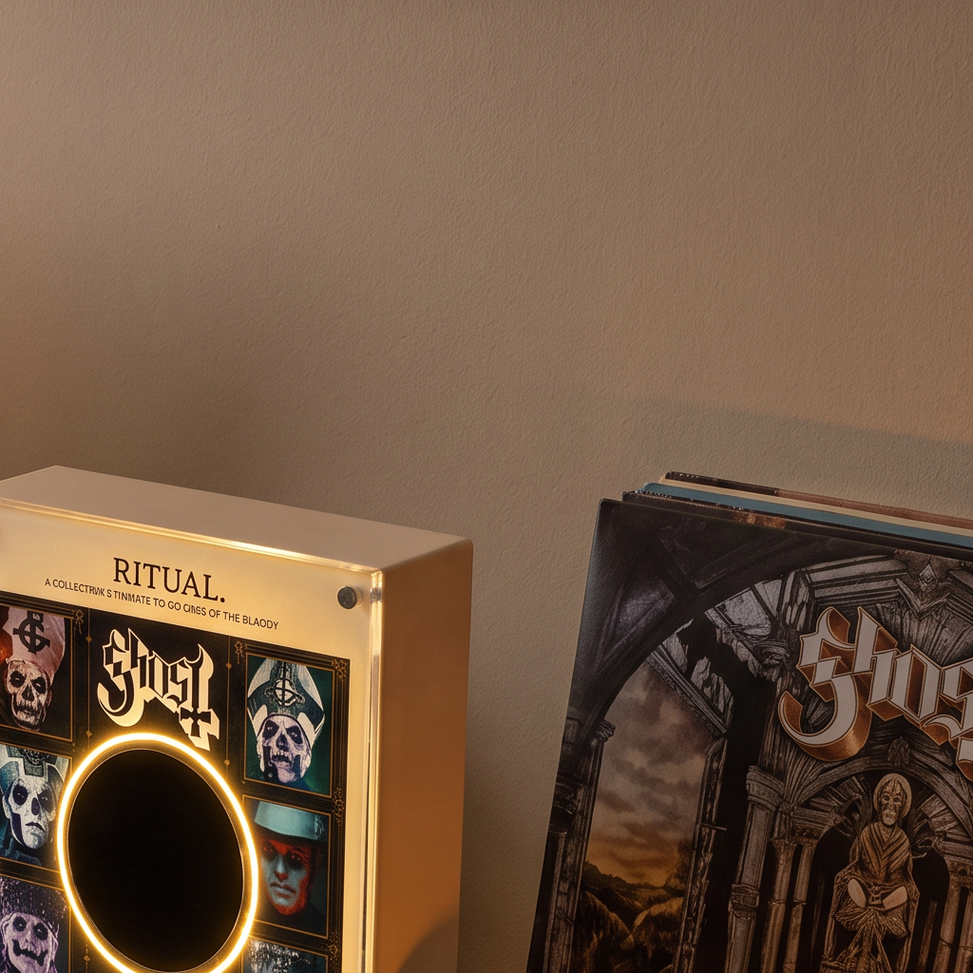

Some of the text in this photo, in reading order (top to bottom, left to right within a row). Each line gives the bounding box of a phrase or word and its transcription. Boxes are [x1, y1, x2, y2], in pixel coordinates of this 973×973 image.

[44, 578, 52, 587] A
[153, 597, 166, 609] TO
[167, 600, 182, 612] GO
[208, 608, 222, 620] OF
[223, 611, 241, 623] THE
[242, 615, 279, 630] BLAODY
[113, 557, 226, 603] RITUAL.
[778, 606, 973, 782] Ghos
